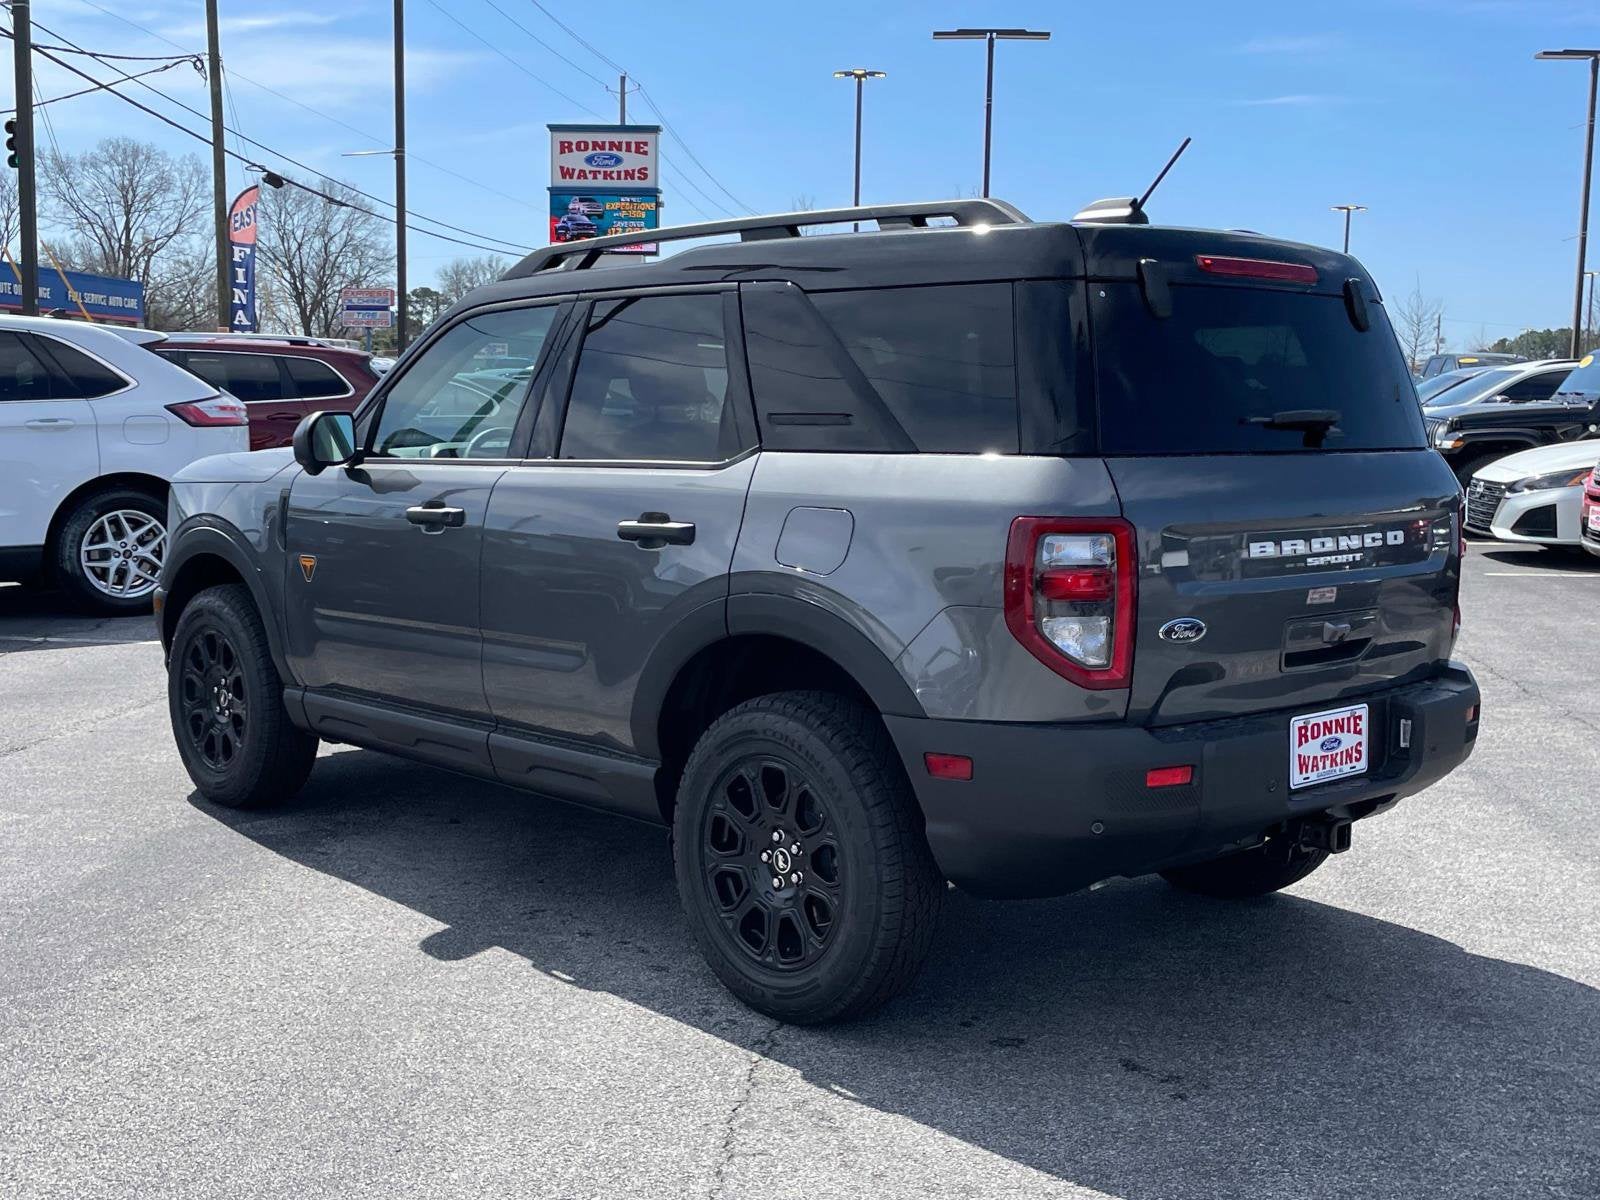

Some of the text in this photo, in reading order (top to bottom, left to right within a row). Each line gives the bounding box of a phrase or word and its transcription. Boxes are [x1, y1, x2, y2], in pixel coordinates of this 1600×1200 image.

[559, 140, 649, 156] RONNIE
[591, 155, 617, 167] Ford
[559, 165, 649, 182] WATKINS
[232, 202, 258, 233] EASY
[232, 245, 252, 333] FINA
[83, 292, 107, 306] SERVICE
[108, 295, 123, 308] AUTO
[123, 297, 138, 310] CARE
[1249, 530, 1405, 557] BRONCO
[1306, 553, 1363, 566] SPORT
[1171, 623, 1198, 639] Ford
[1297, 714, 1363, 749] RONNIE
[1322, 737, 1341, 751] Ford
[1297, 741, 1363, 776] WATKINS
